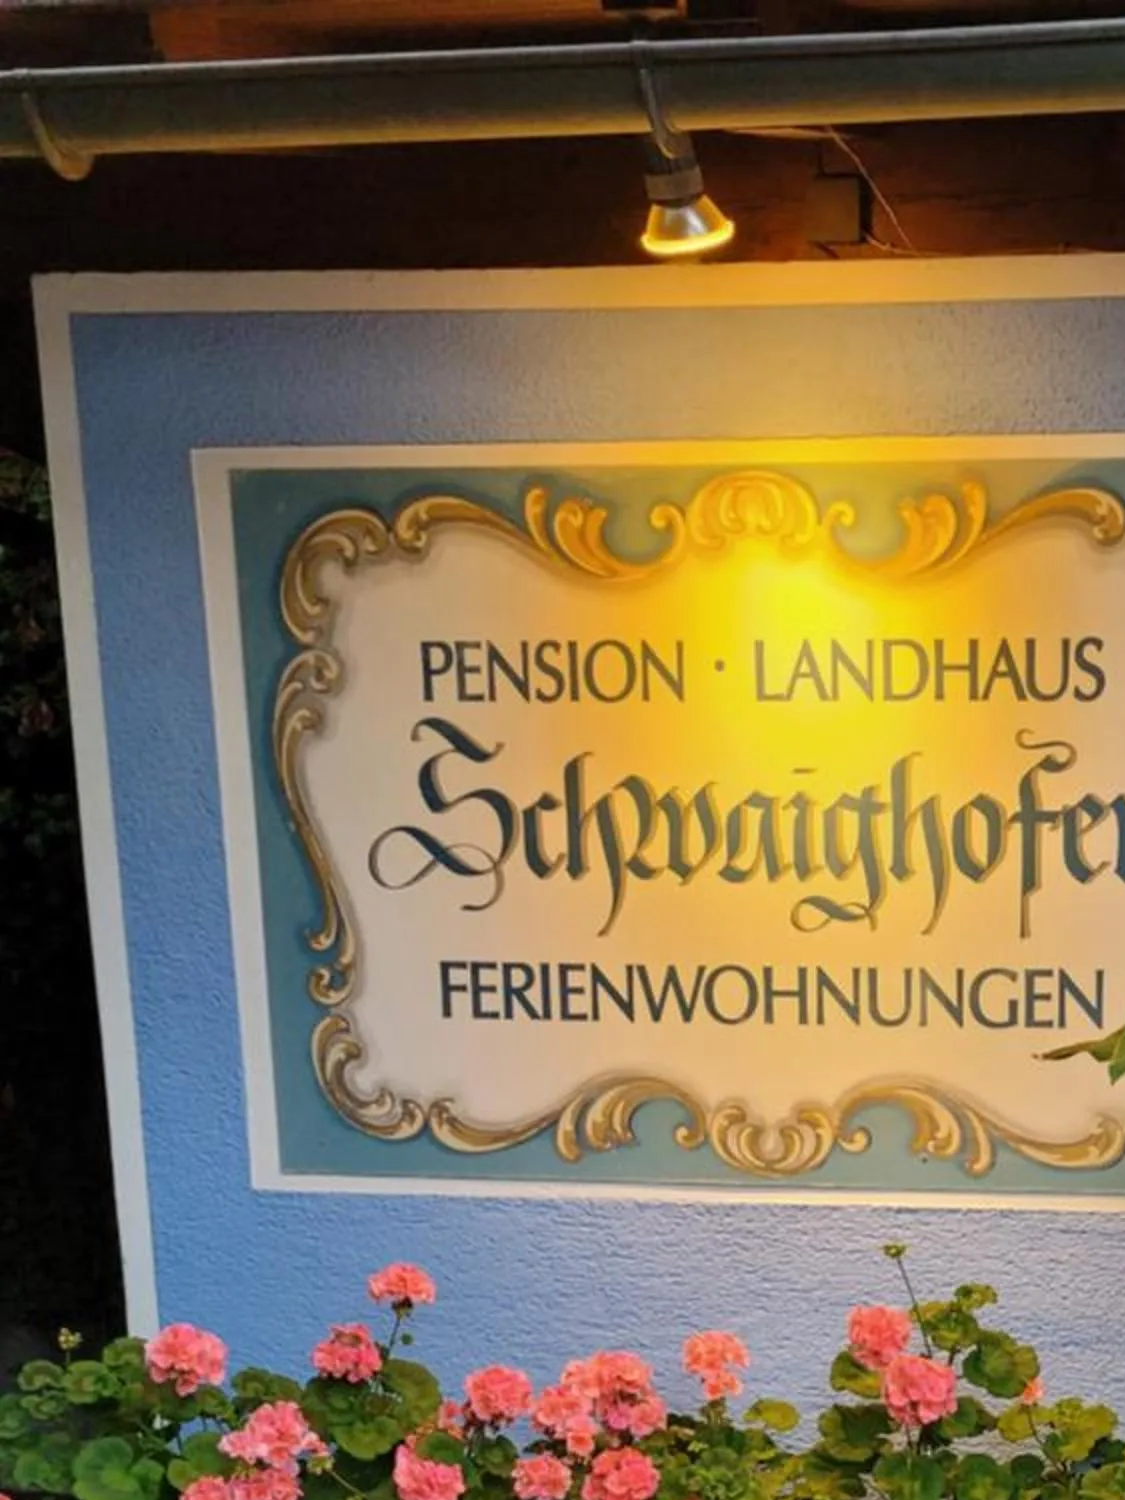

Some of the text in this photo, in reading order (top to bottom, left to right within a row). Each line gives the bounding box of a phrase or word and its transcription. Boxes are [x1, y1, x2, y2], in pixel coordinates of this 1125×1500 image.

[419, 639, 685, 703] PENSION
[753, 636, 1106, 703] LANDHAUS
[438, 960, 1106, 1030] FERIENWOHNUNGEN
